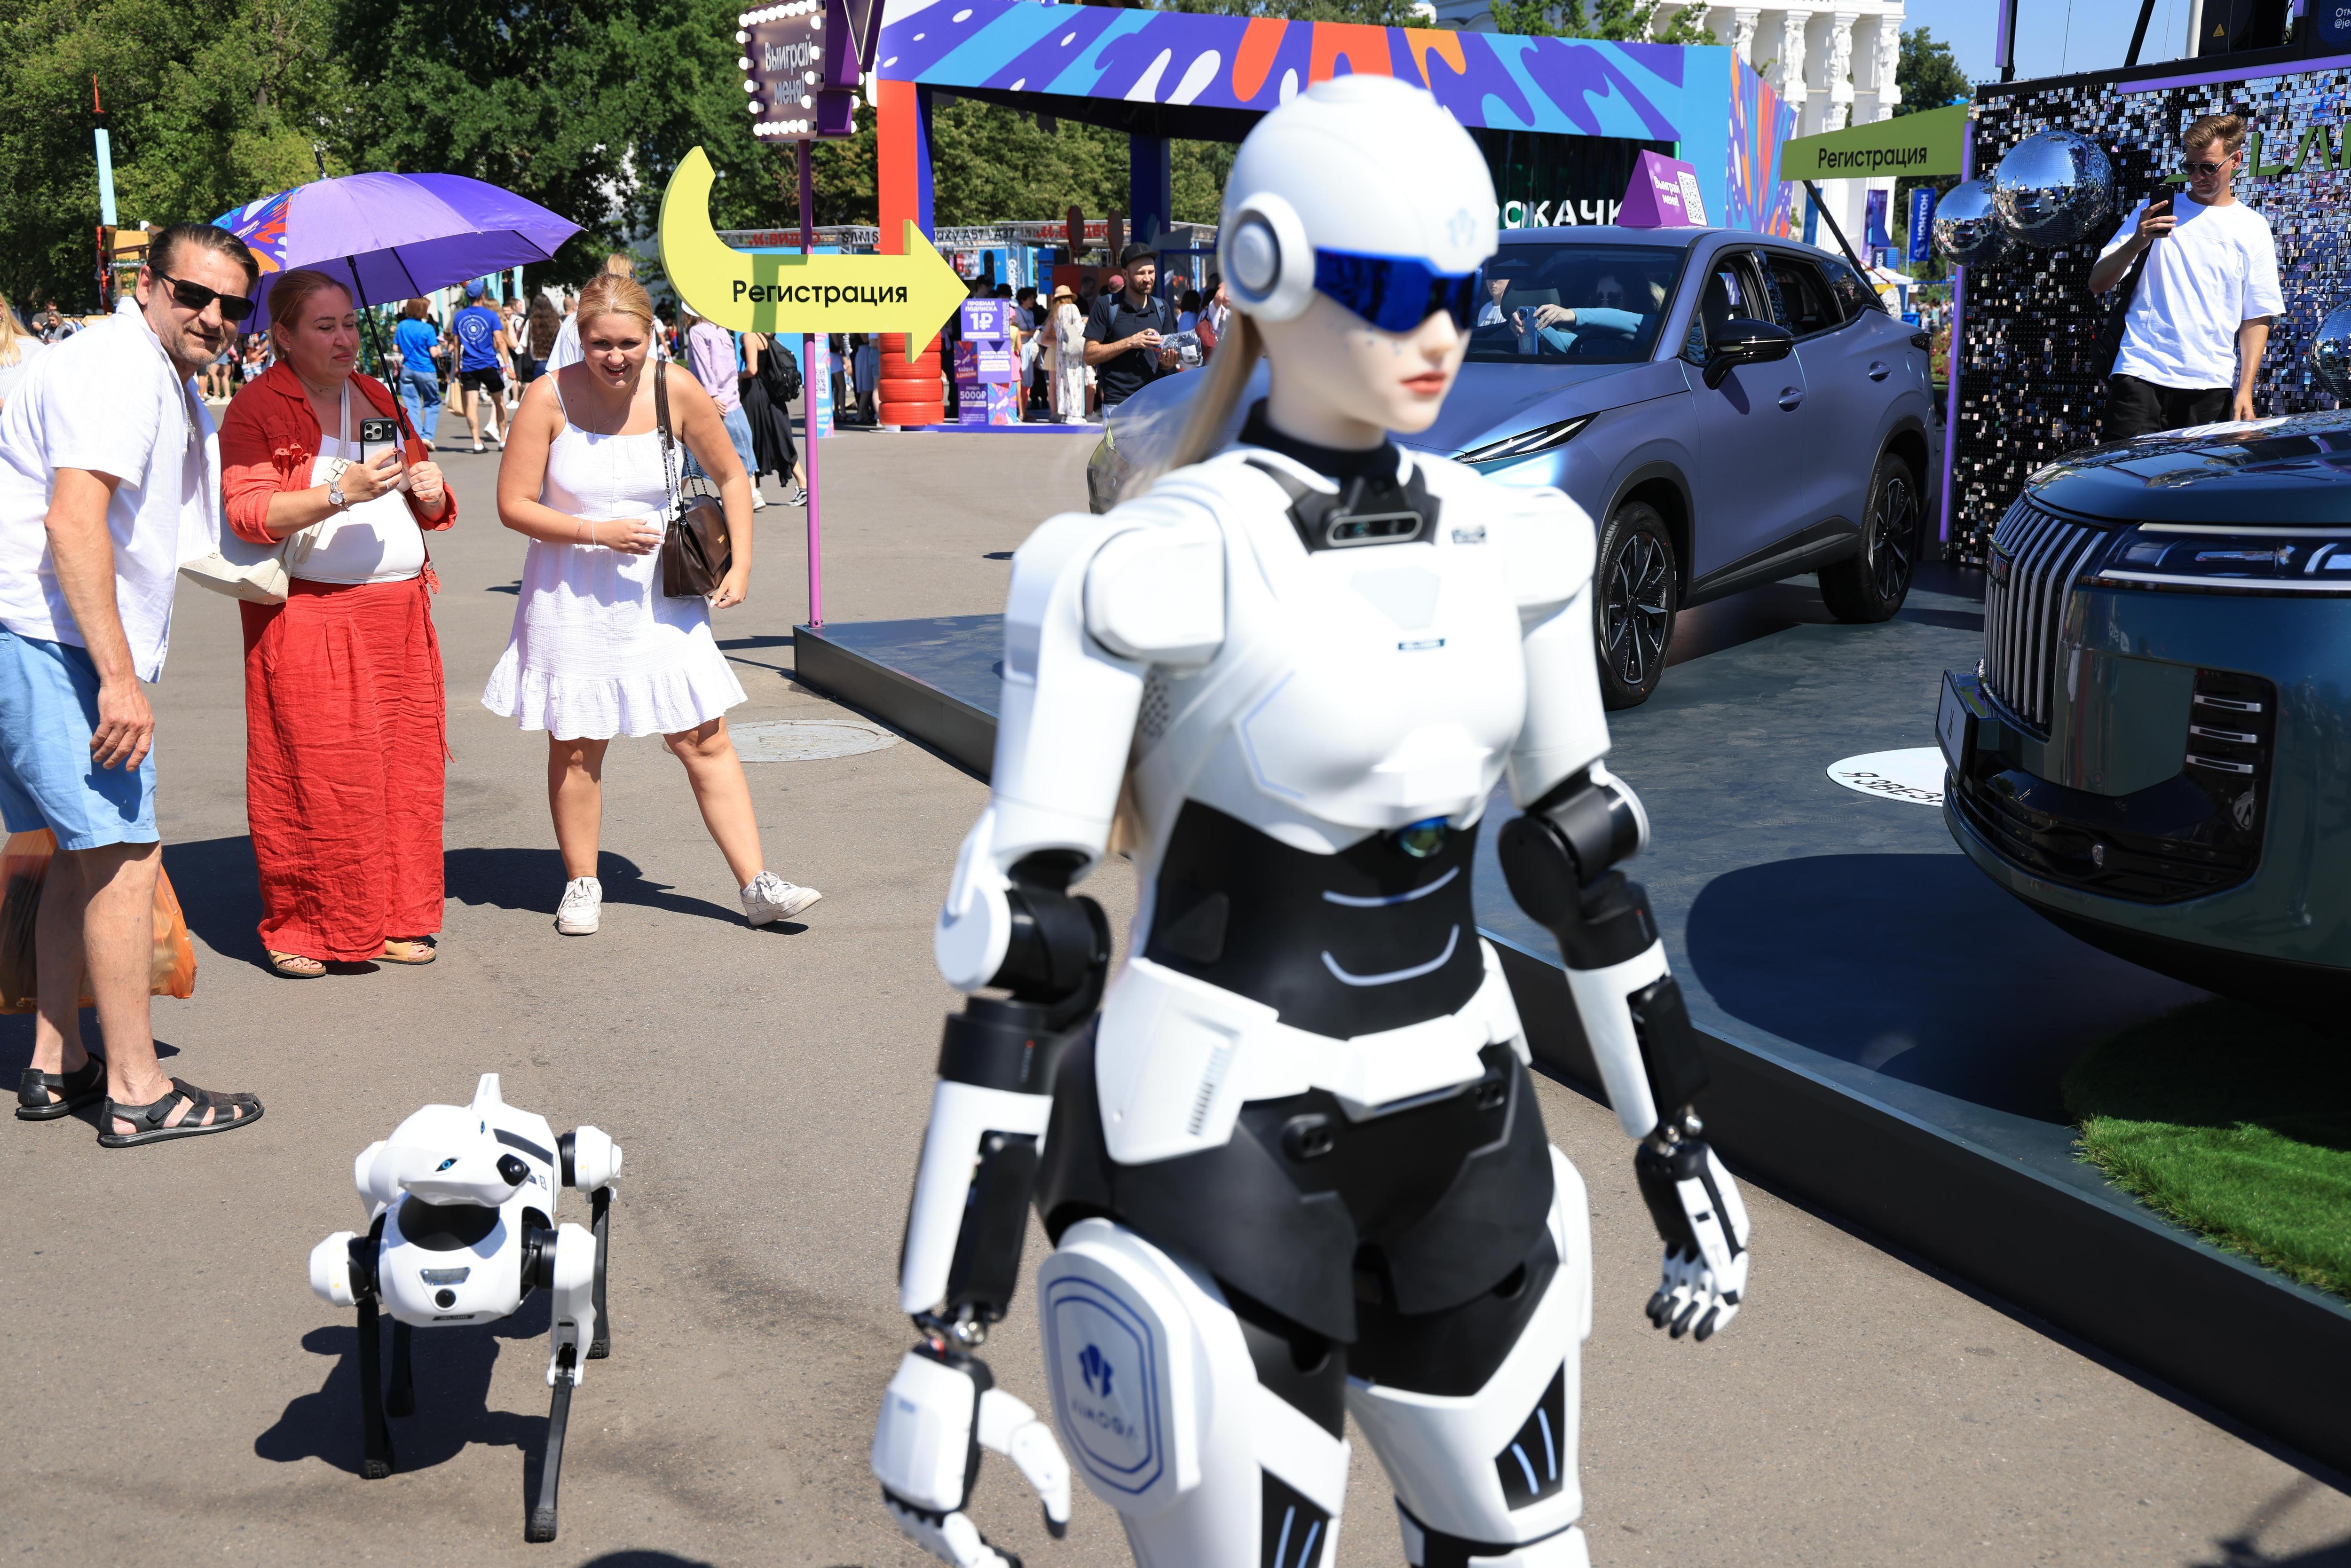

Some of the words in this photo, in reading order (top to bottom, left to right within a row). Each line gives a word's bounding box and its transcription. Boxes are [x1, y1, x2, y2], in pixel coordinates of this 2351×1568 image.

[2334, 18, 2351, 29] @je
[765, 33, 813, 76] Выиграй
[774, 71, 805, 105] меня!
[1818, 147, 1927, 171] Регистрация
[1653, 175, 1680, 196] Выиграй
[1662, 194, 1680, 207] меня!
[749, 231, 820, 246] М.ВИДО
[842, 230, 880, 243] SAMS
[733, 280, 907, 307] Регистрация
[970, 312, 994, 330] 1₽
[960, 391, 986, 400] 5000₽
[1853, 780, 1943, 802] ЗВЕЗ
